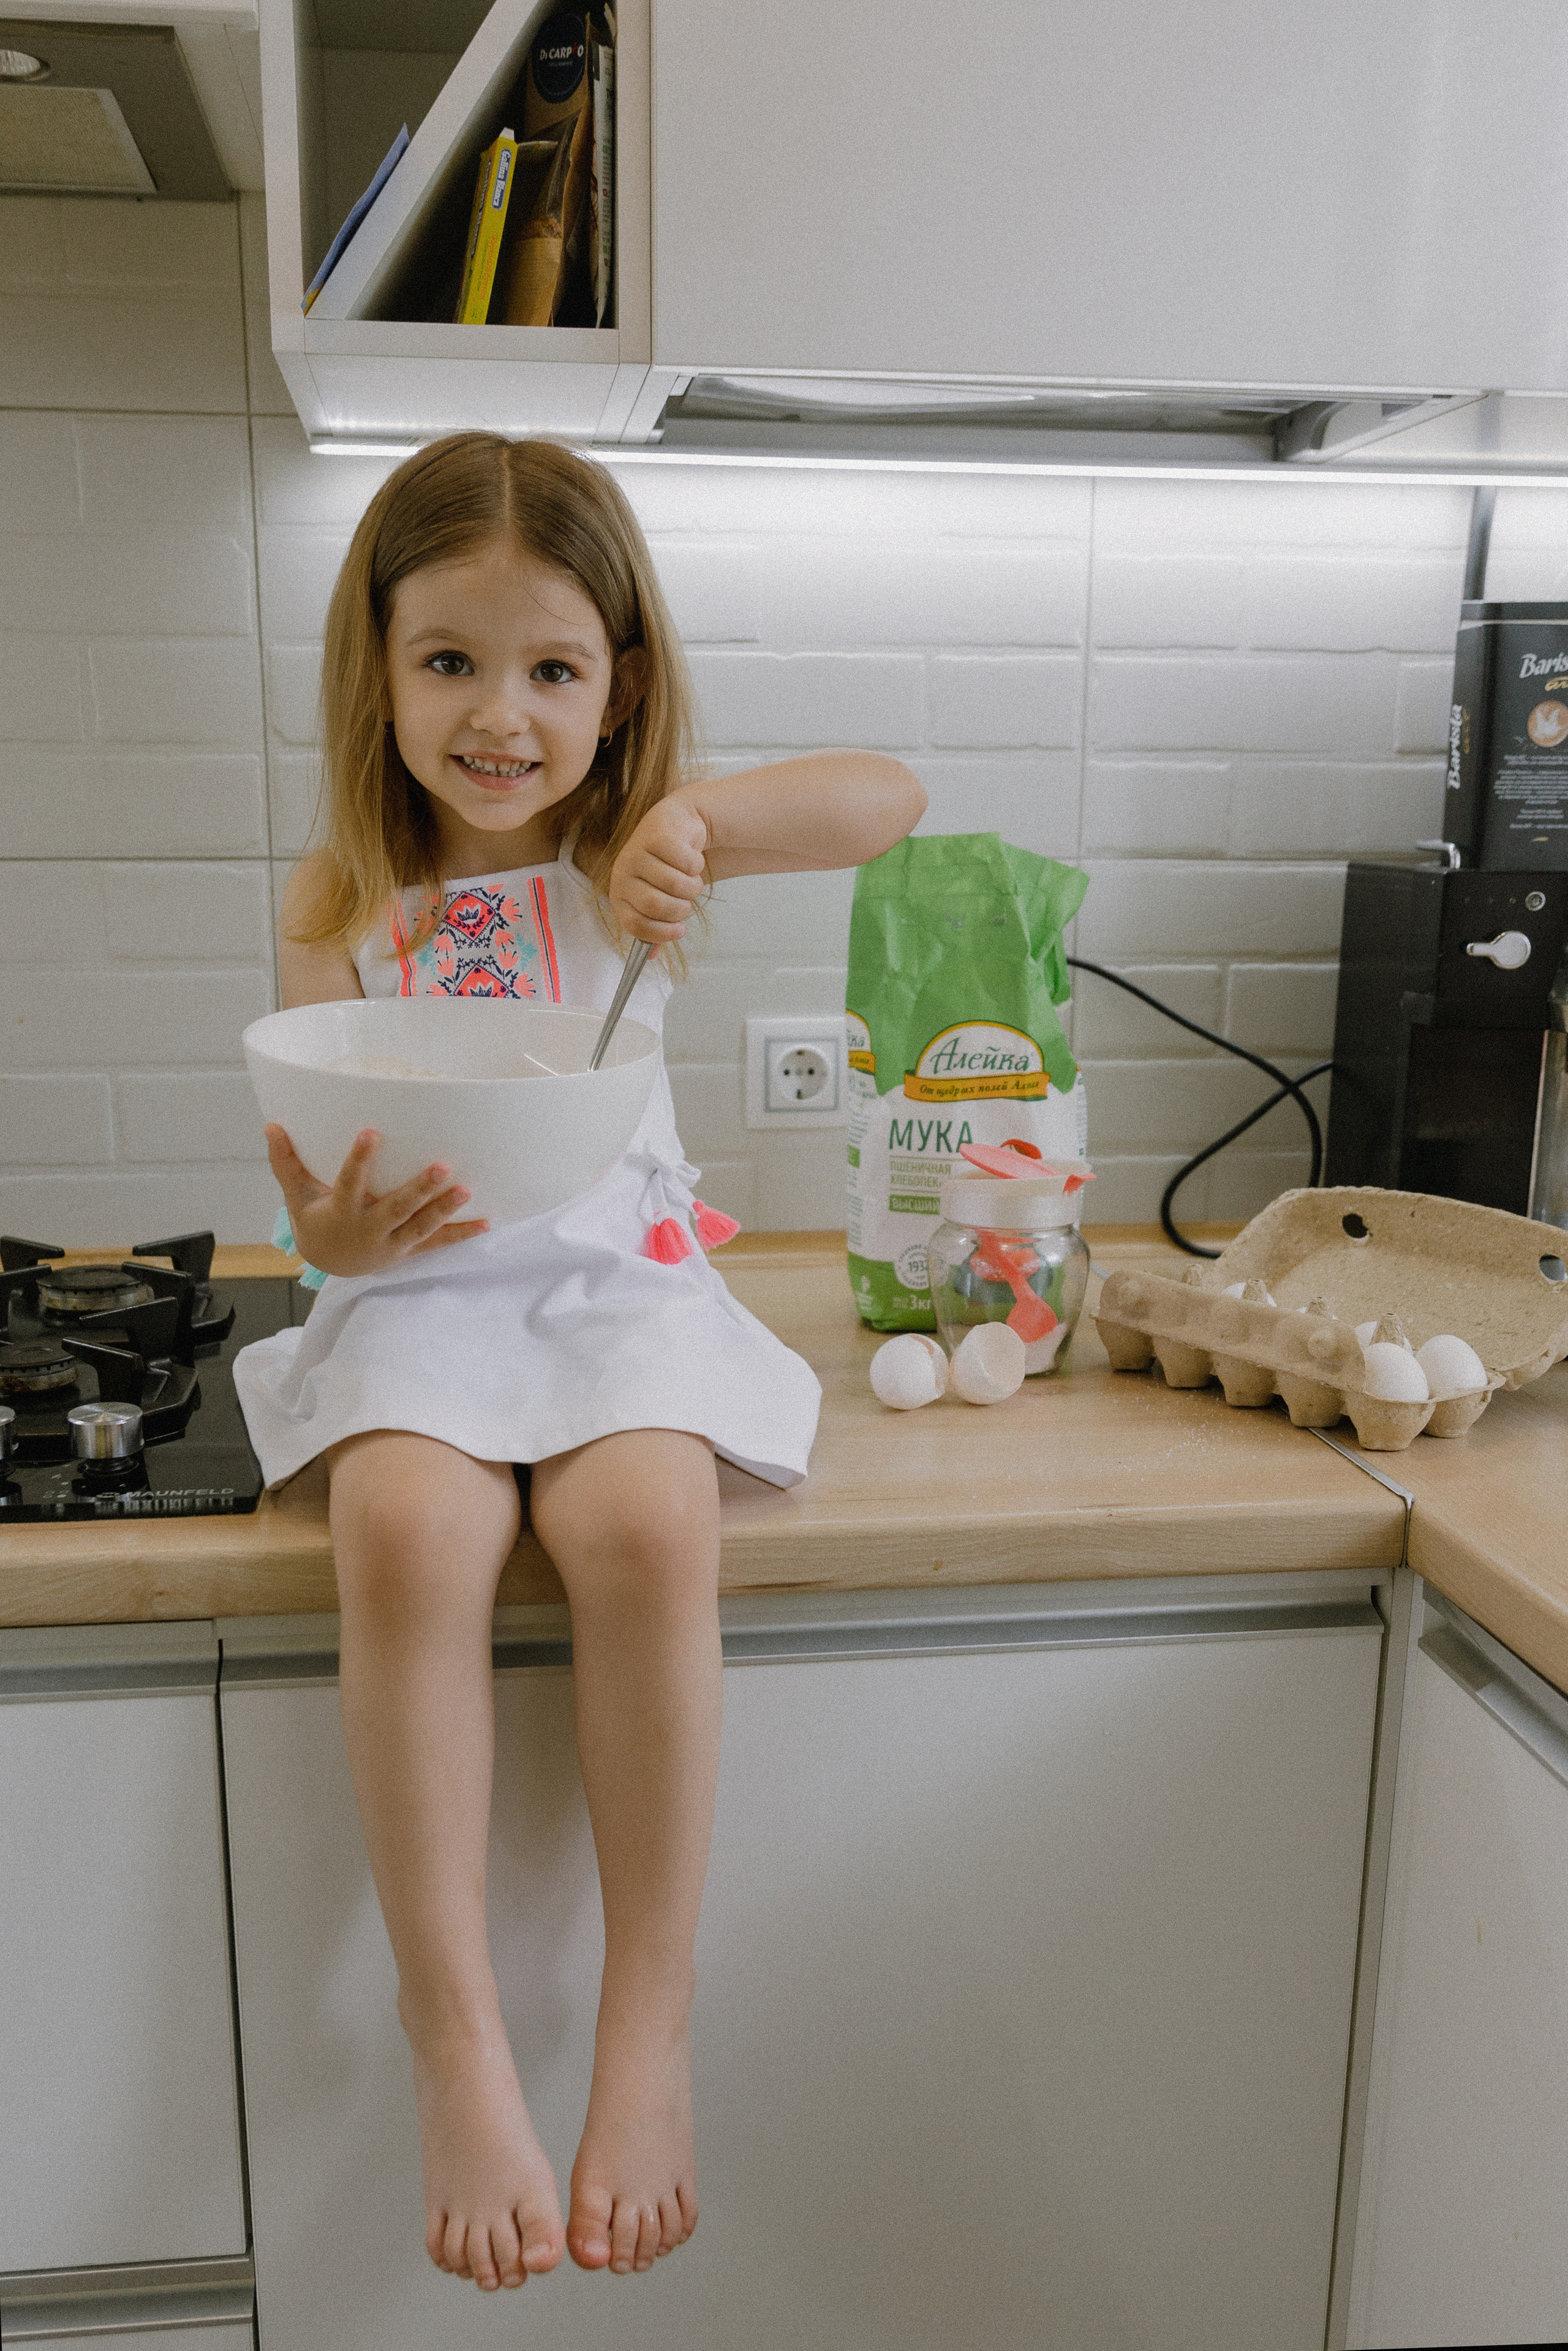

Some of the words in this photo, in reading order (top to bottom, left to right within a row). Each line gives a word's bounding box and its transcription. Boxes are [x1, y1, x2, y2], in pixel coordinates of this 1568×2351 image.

[498, 150, 511, 179] Gallina
[492, 179, 506, 206] Blanca
[1447, 704, 1463, 790] Barista
[929, 1036, 1030, 1075] Алейка
[920, 1084, 934, 1095] От
[936, 1083, 975, 1097] щедрых
[978, 1081, 1008, 1093] полей
[889, 1119, 973, 1153] МУКА
[890, 1161, 951, 1175] ПШЕНИЧНАЯ
[890, 1174, 941, 1188] ХЛЕБОПЕК
[124, 1488, 235, 1498] MAUNFELD
